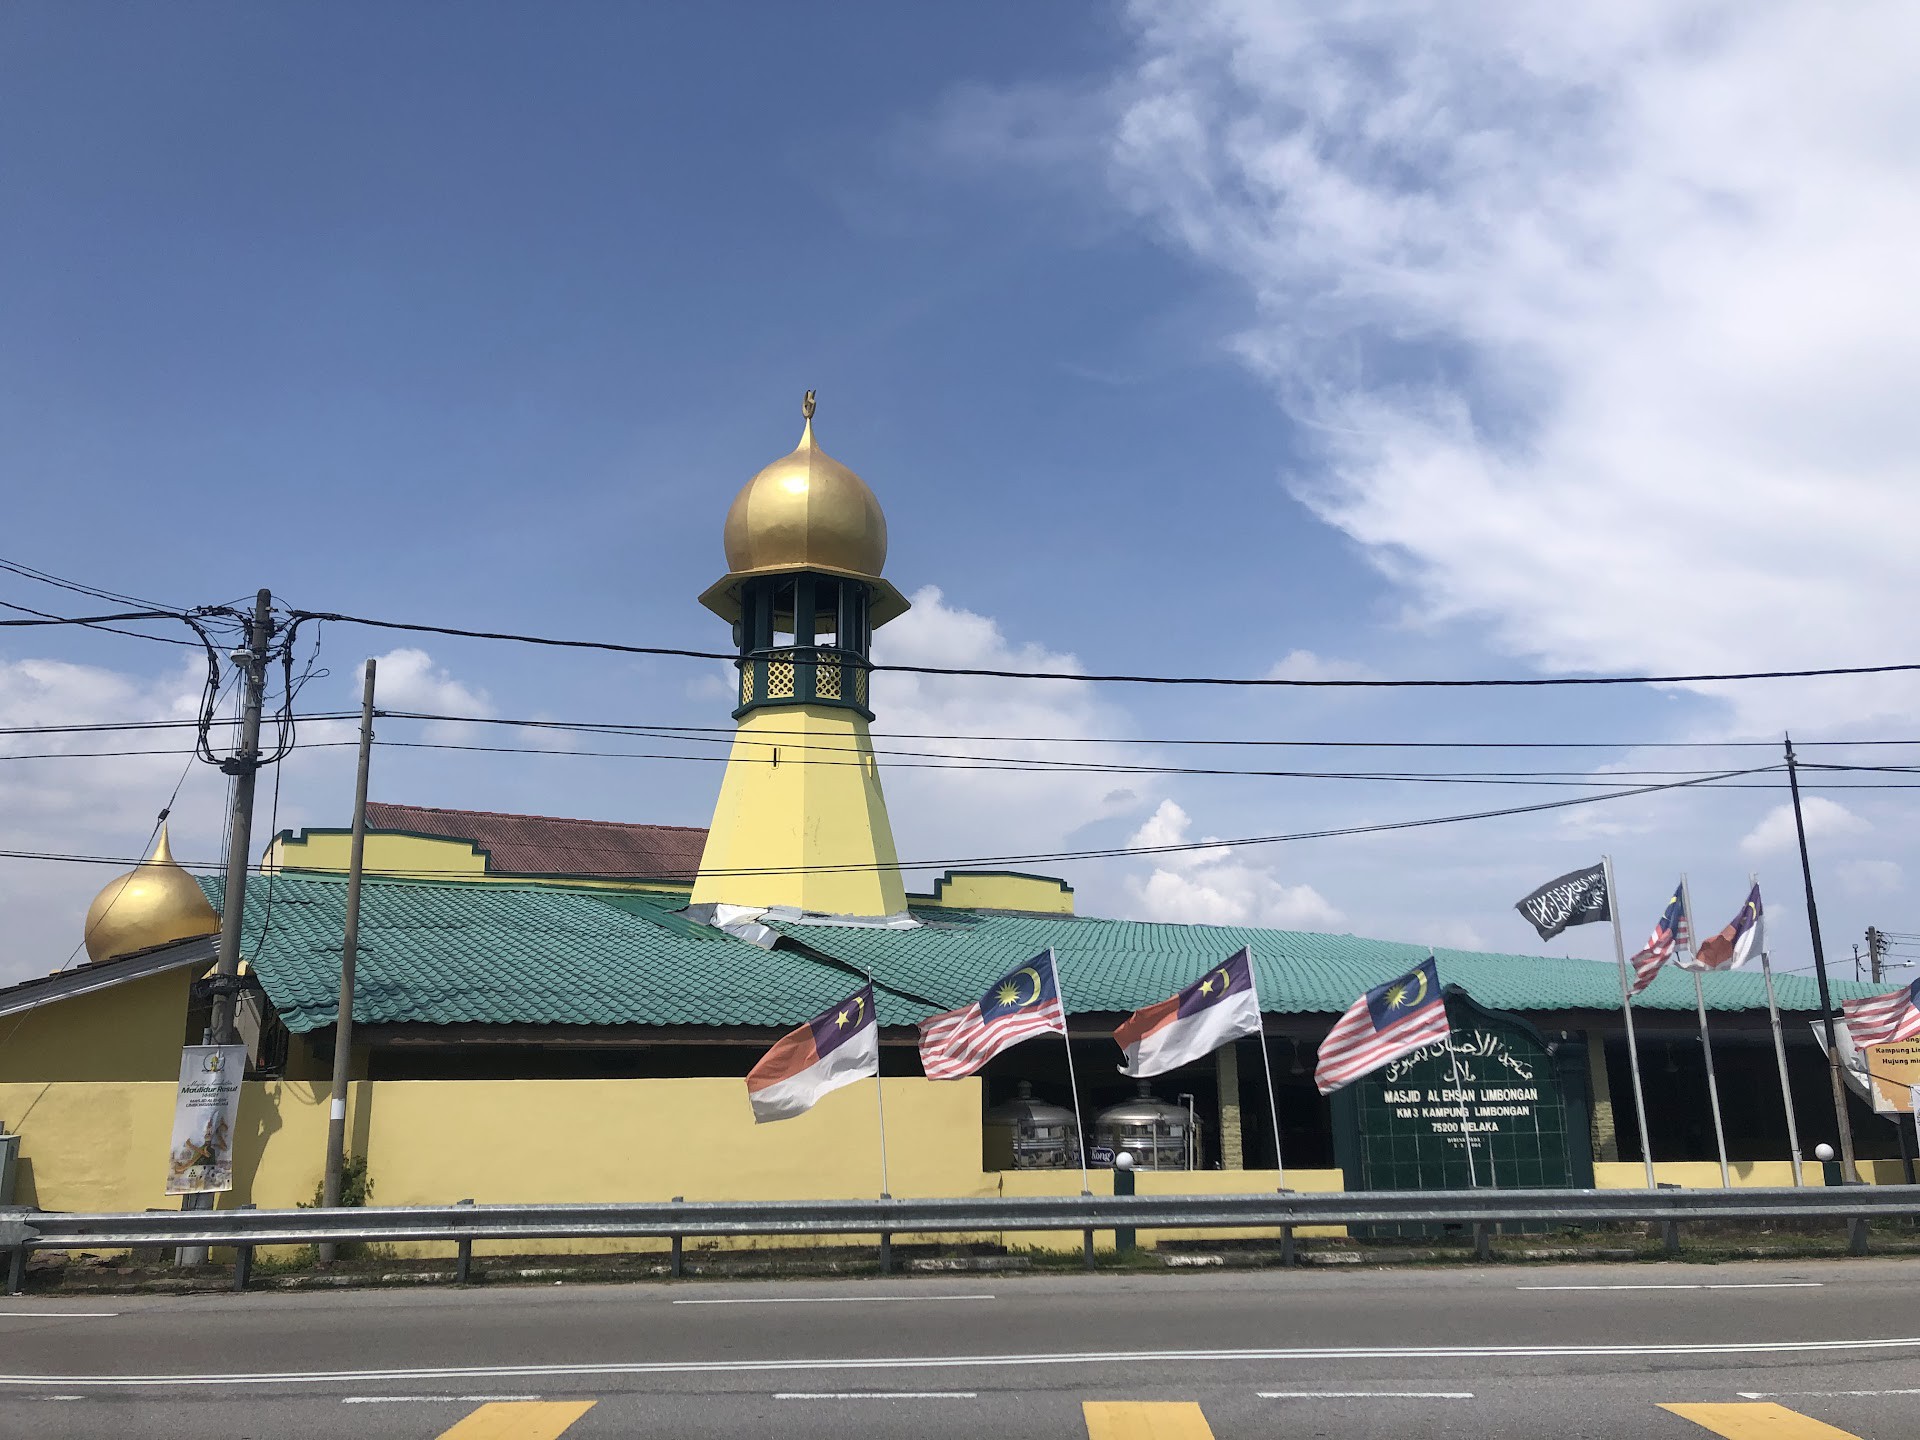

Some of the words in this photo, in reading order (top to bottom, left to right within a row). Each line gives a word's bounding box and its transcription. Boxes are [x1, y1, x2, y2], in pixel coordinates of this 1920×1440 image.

[1383, 1090, 1421, 1104] MASJID
[1427, 1089, 1440, 1102] AL
[1442, 1089, 1476, 1102] EHSAN
[1480, 1088, 1538, 1102] LIMBONGAN
[1396, 1107, 1412, 1118] KM
[1412, 1108, 1419, 1118] 3
[1422, 1107, 1469, 1118] KAMPUNG
[1474, 1106, 1530, 1117] LIMBONGAN
[1431, 1122, 1458, 1133] 75200
